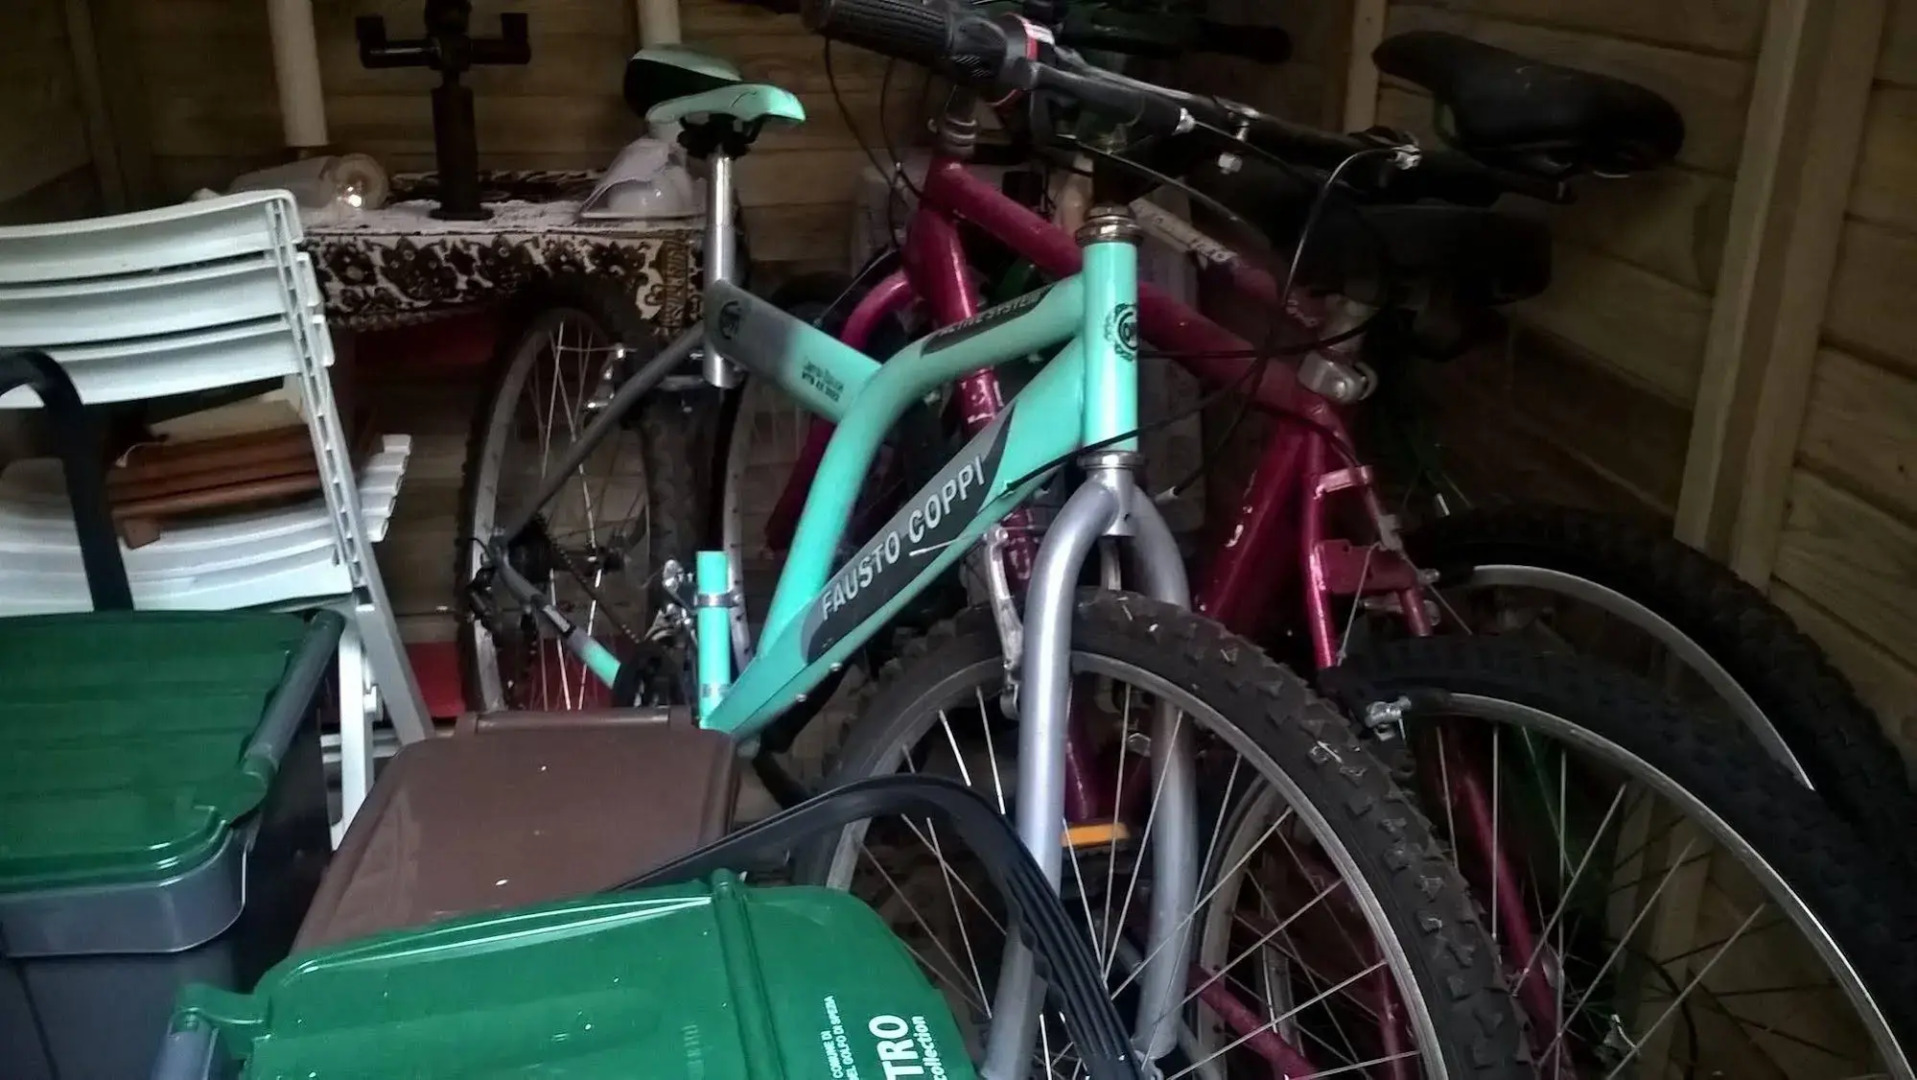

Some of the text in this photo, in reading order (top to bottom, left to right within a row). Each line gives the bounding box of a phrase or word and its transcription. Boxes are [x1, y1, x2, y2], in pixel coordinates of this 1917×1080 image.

[822, 455, 985, 621] FAUSTO COPPI
[823, 995, 841, 1025] SPEZIA
[820, 1030, 833, 1041] DI
[832, 1025, 844, 1035] DI
[835, 1035, 854, 1065] GOLFO
